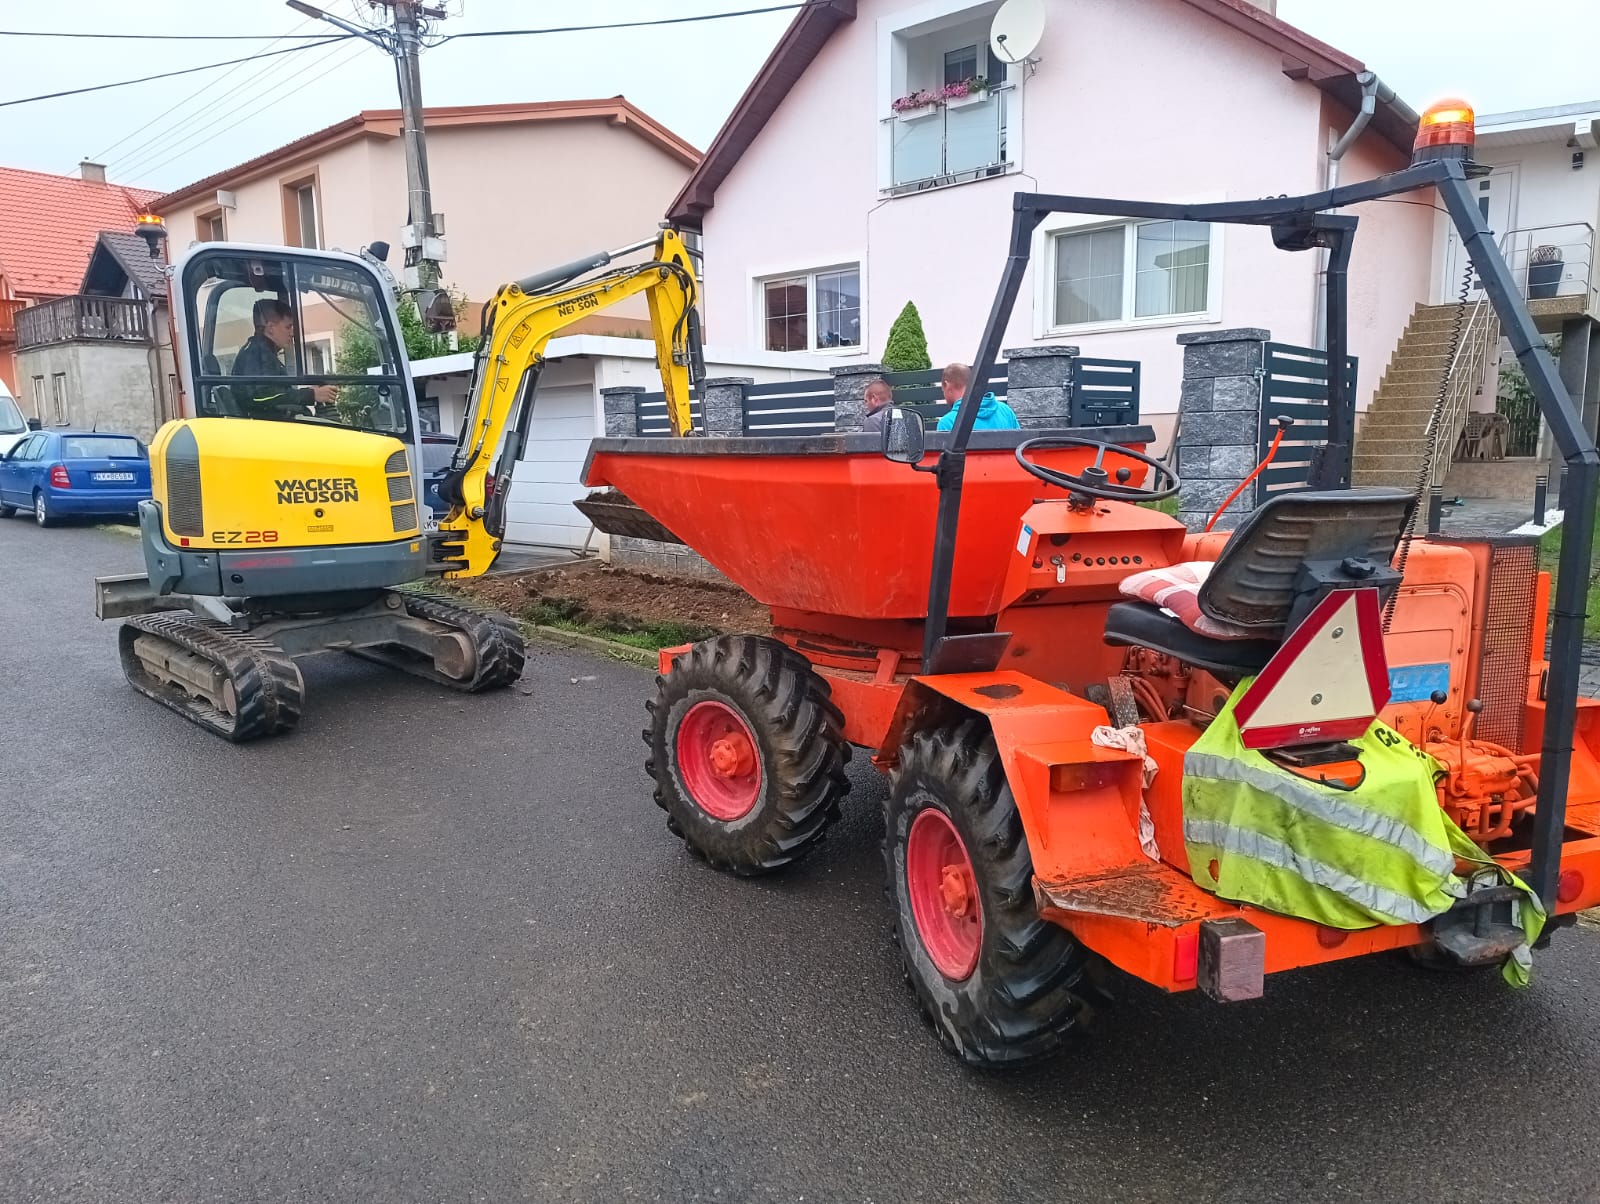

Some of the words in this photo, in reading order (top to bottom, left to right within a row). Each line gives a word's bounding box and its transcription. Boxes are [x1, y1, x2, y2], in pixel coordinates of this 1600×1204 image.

[274, 478, 358, 491] WACKER
[277, 490, 359, 504] NEUSON
[212, 530, 279, 543] EZ28
